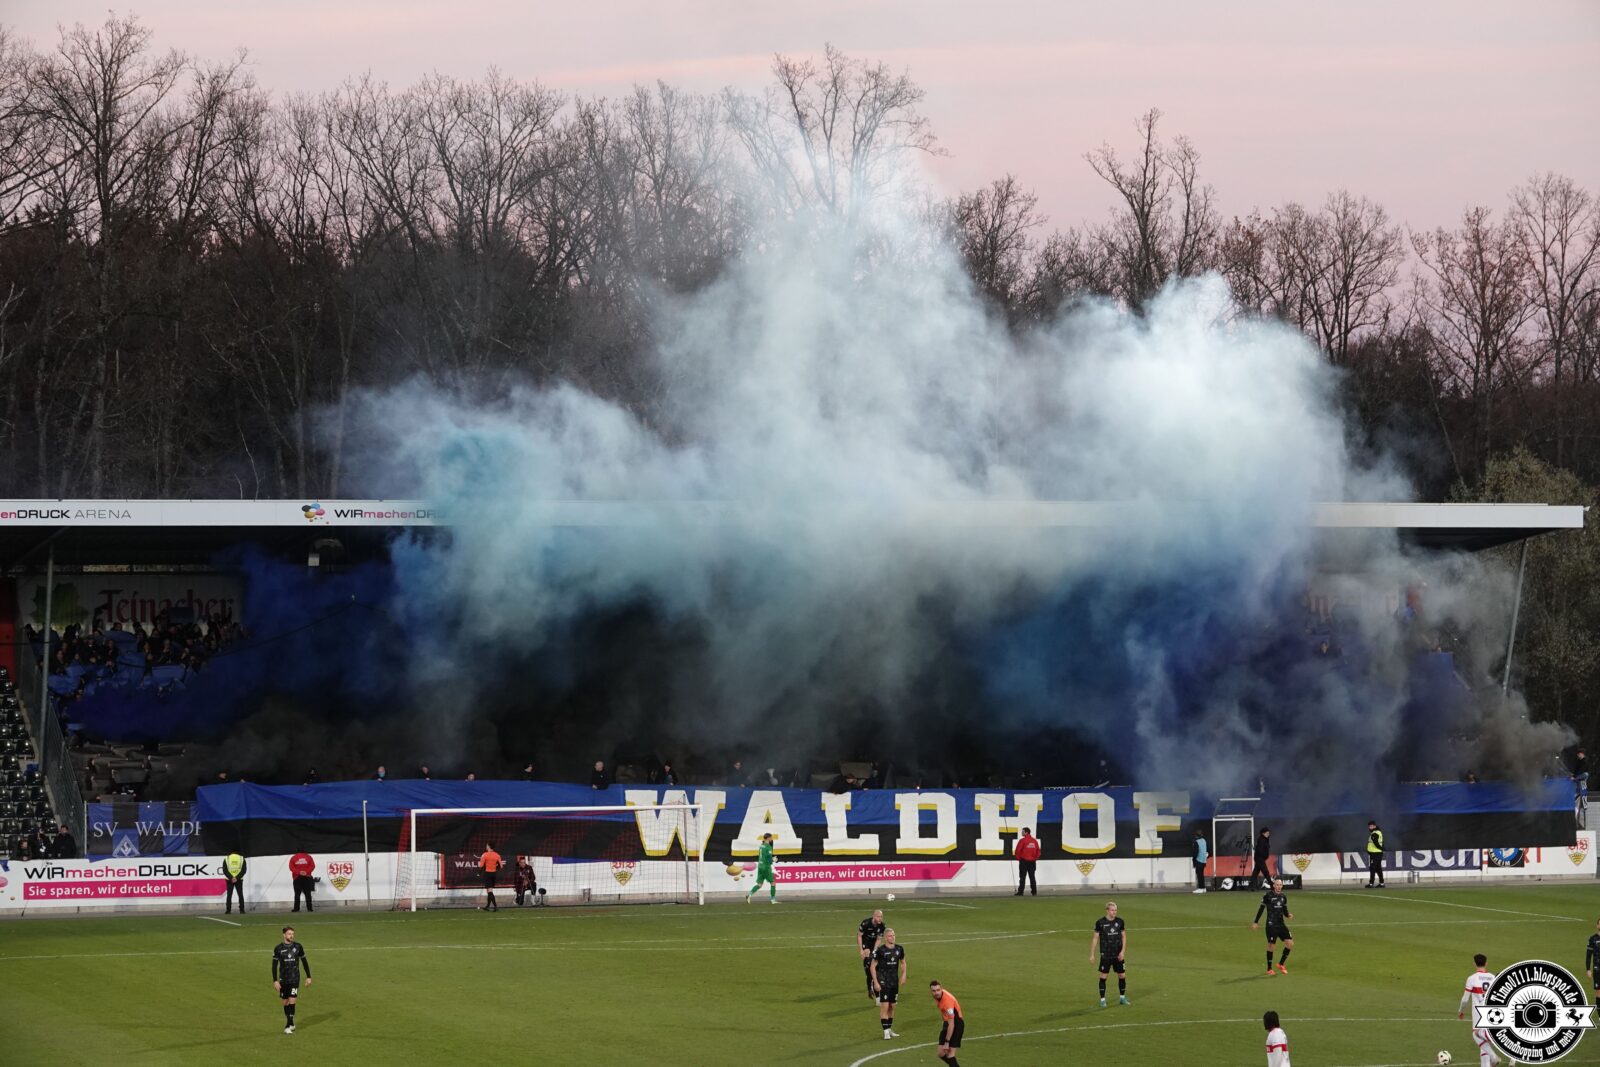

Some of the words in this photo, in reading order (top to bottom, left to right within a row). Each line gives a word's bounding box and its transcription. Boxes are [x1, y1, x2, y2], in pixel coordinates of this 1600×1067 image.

[74, 509, 131, 519] ARENA
[93, 821, 119, 838] SV
[625, 790, 1190, 857] WALDHOF
[775, 870, 791, 879] Sie
[794, 869, 834, 880] sparen,
[838, 868, 855, 877] wir
[858, 867, 906, 877] drucken!
[28, 886, 46, 896] Sie
[49, 886, 94, 898] sparen,
[97, 884, 116, 894] wir
[119, 883, 172, 894] drucken!
